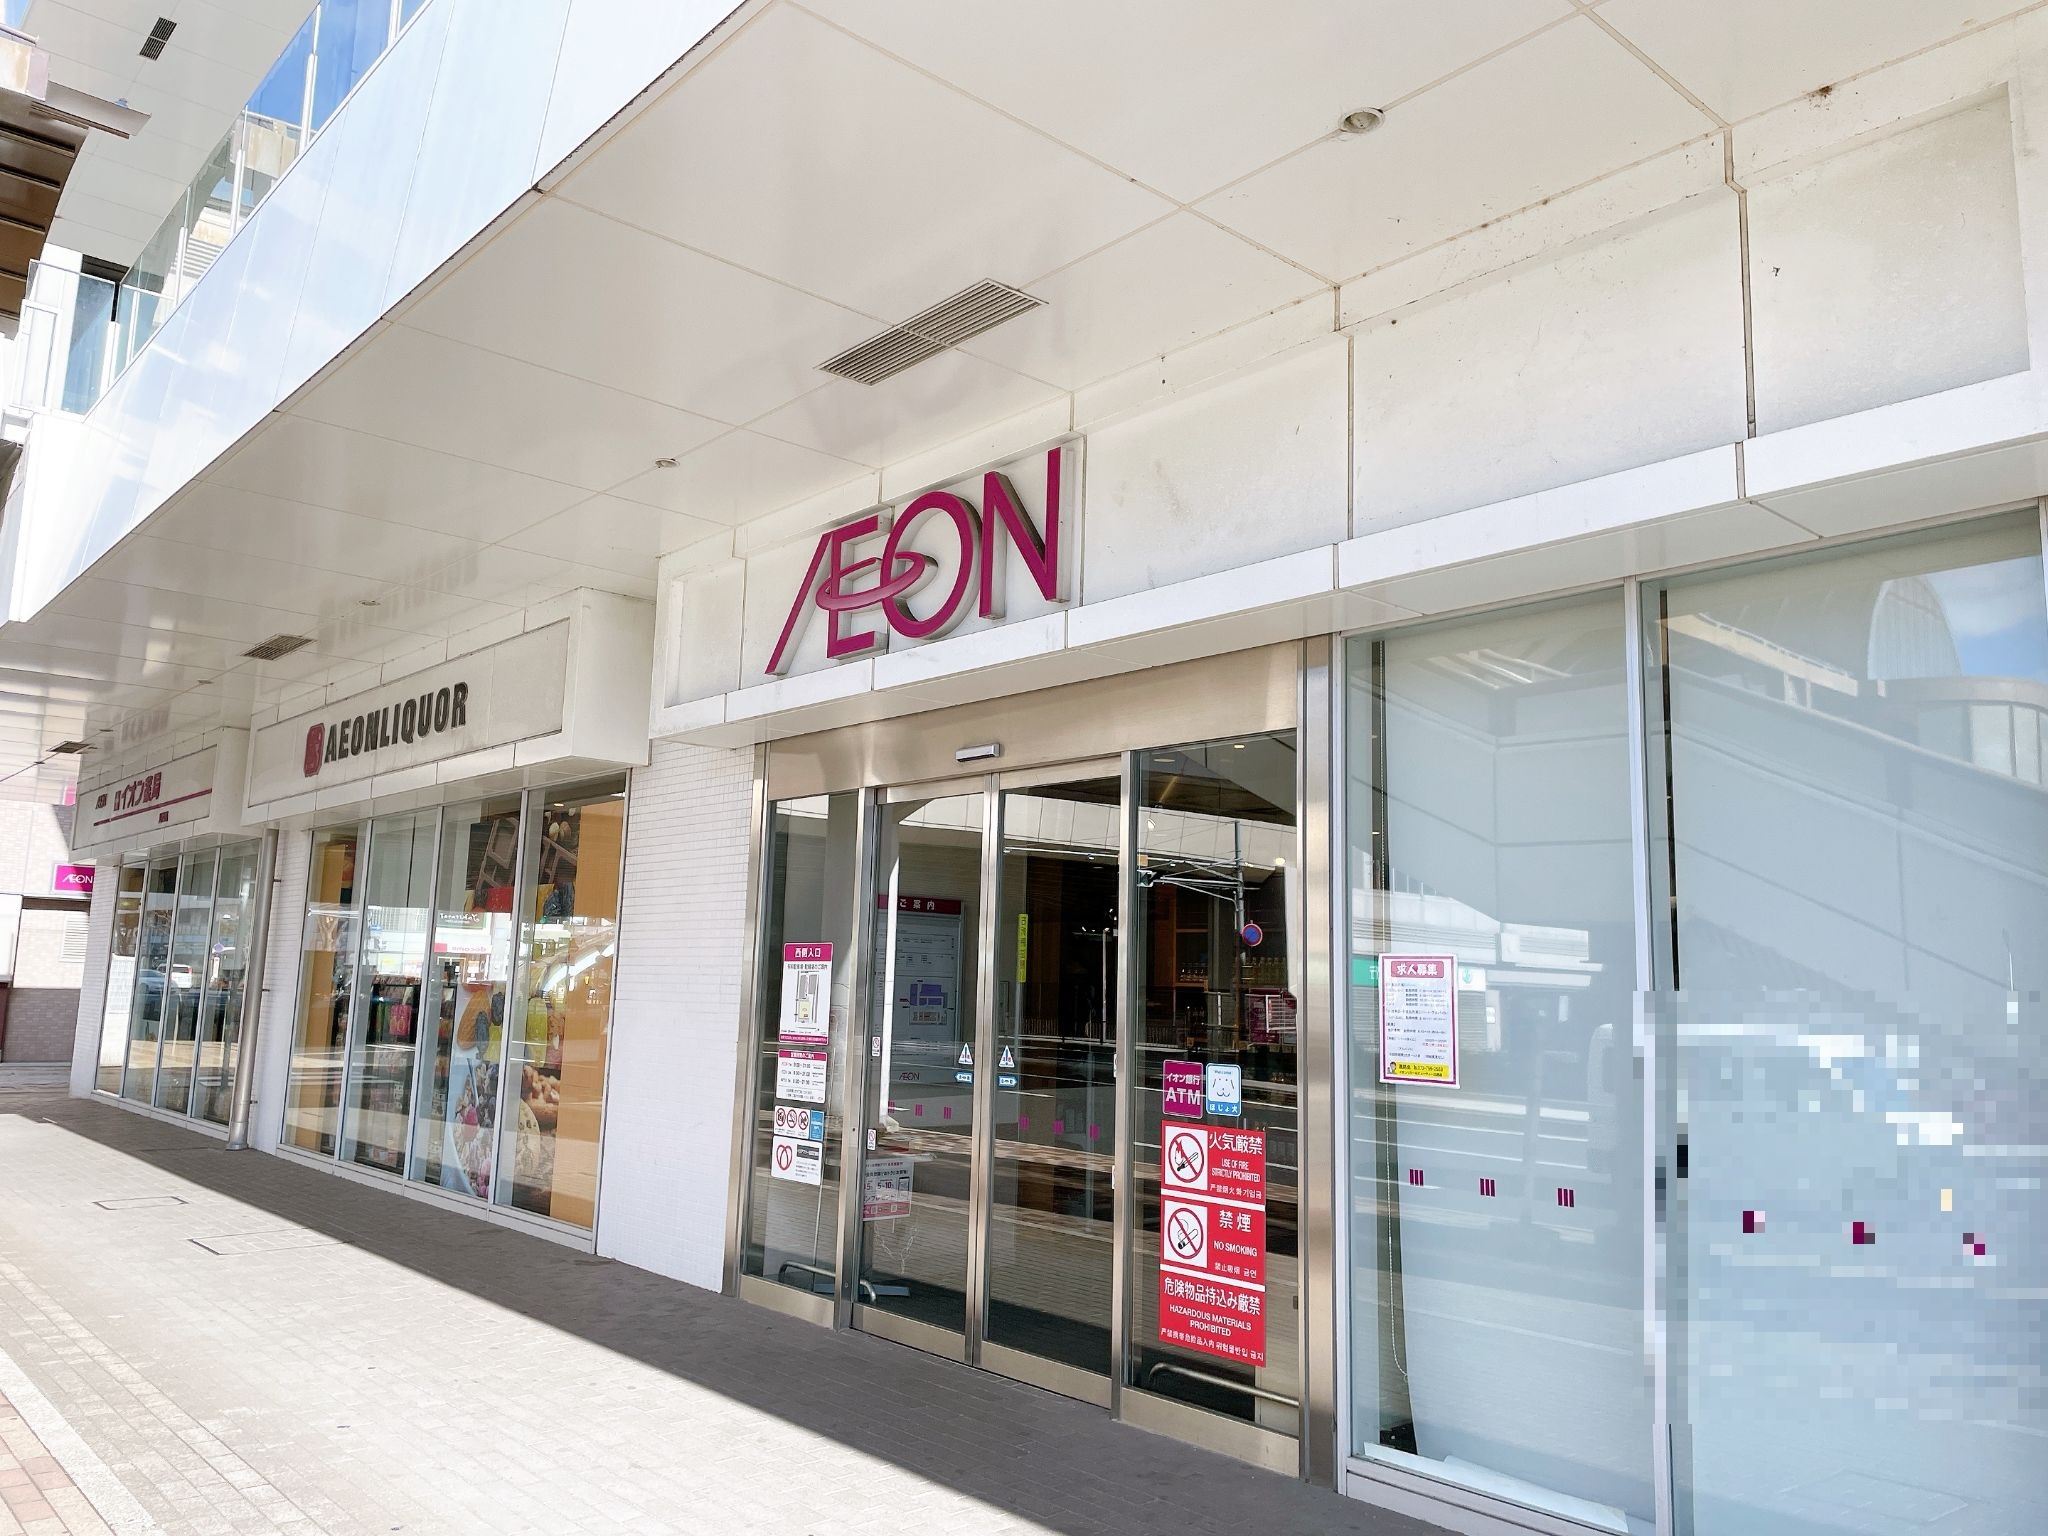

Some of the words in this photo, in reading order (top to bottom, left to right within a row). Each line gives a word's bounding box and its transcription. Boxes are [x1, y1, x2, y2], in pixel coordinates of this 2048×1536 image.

[323, 681, 469, 763] AEONLIQUOR
[1397, 963, 1438, 976] 求人募集
[1166, 1072, 1201, 1086] イオン銀行
[1165, 1087, 1201, 1106] ATM
[1209, 1103, 1238, 1113] ほじょ犬
[1209, 1131, 1263, 1155] 火気厳禁
[1221, 1158, 1231, 1166] USE
[1231, 1159, 1237, 1167] OF
[1238, 1160, 1249, 1169] FIRE
[1211, 1168, 1233, 1179] STRICTLY
[1232, 1170, 1261, 1183] PROHIBITED
[1219, 1209, 1252, 1233] 禁煙
[1213, 1240, 1224, 1251] NO
[1225, 1242, 1258, 1257] SMOKING
[1164, 1276, 1261, 1316] 危険物品持込み厳禁
[1169, 1304, 1211, 1321] HAZARDOUS
[1211, 1312, 1252, 1331] MATERIALS
[1189, 1319, 1232, 1337] PROHIBITED
